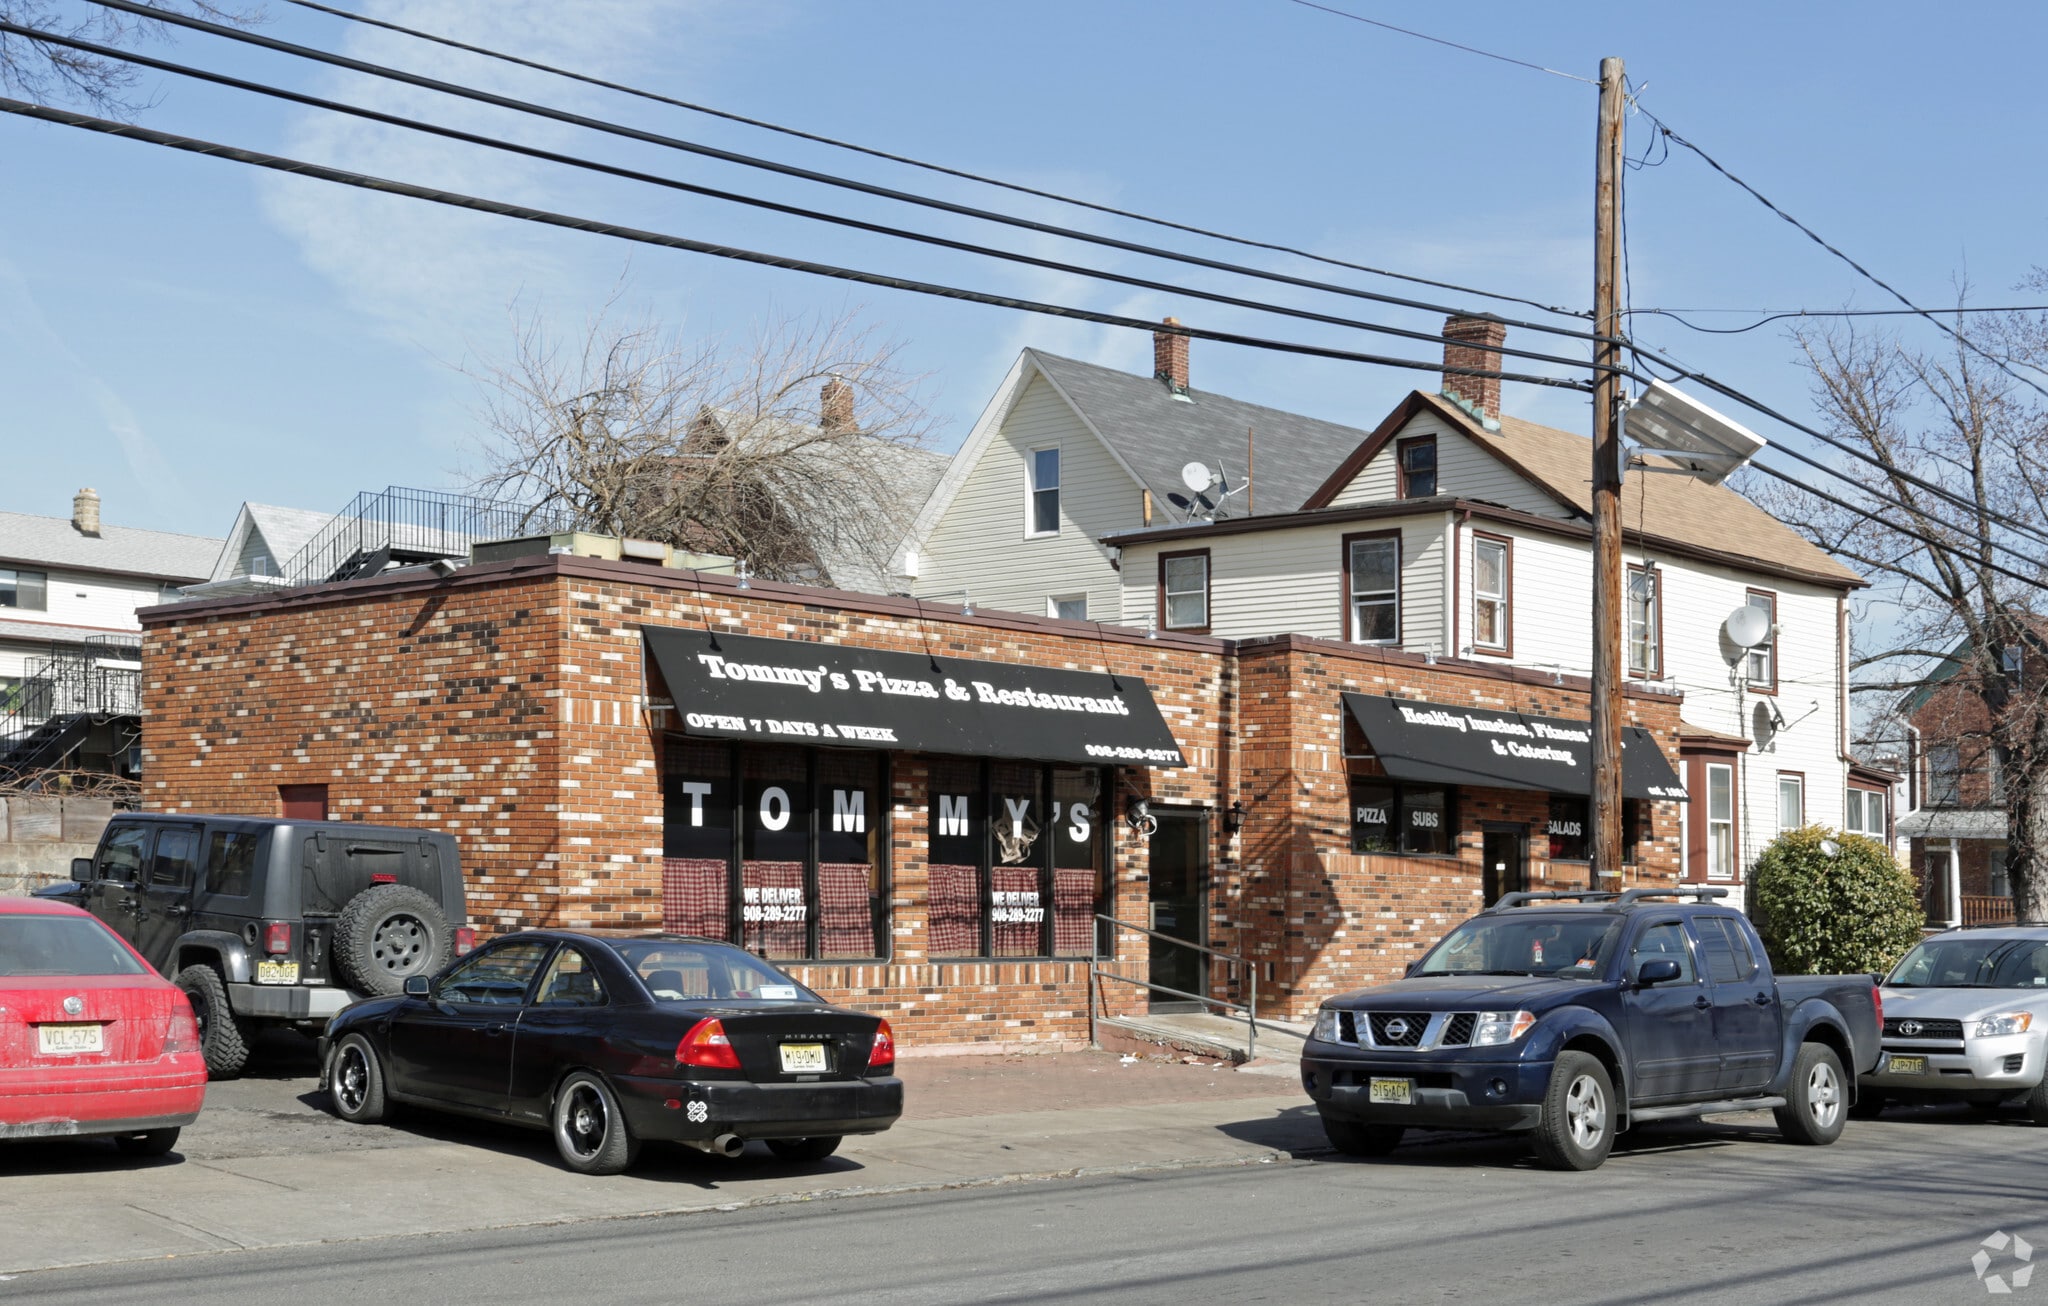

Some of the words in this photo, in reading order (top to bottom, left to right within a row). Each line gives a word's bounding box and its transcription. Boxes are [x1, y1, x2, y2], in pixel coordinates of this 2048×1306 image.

[698, 653, 850, 693] Tommy's
[852, 669, 939, 698] Pizza
[943, 678, 970, 701] &
[971, 681, 1129, 715] Restaurant
[686, 713, 747, 731] OPEN
[750, 719, 762, 732] 7
[765, 719, 819, 736] DAYS
[821, 724, 838, 738] A
[837, 724, 898, 742] WEEK
[1399, 706, 1466, 732] Healthy
[1465, 715, 1535, 738] lunches,
[1531, 723, 1590, 743] Fitness
[1491, 739, 1508, 756] &
[1507, 741, 1576, 766] Catering
[1357, 808, 1387, 824] PIZZA
[1412, 811, 1438, 828] SUBS
[1549, 820, 1581, 836] SALADS
[744, 887, 759, 904] WE
[761, 888, 800, 905] DELIVER
[992, 892, 1006, 906] WE
[1006, 892, 1040, 907] DELIVER
[743, 905, 807, 922] 908-289-2277
[992, 907, 1044, 923] 908-289-2277
